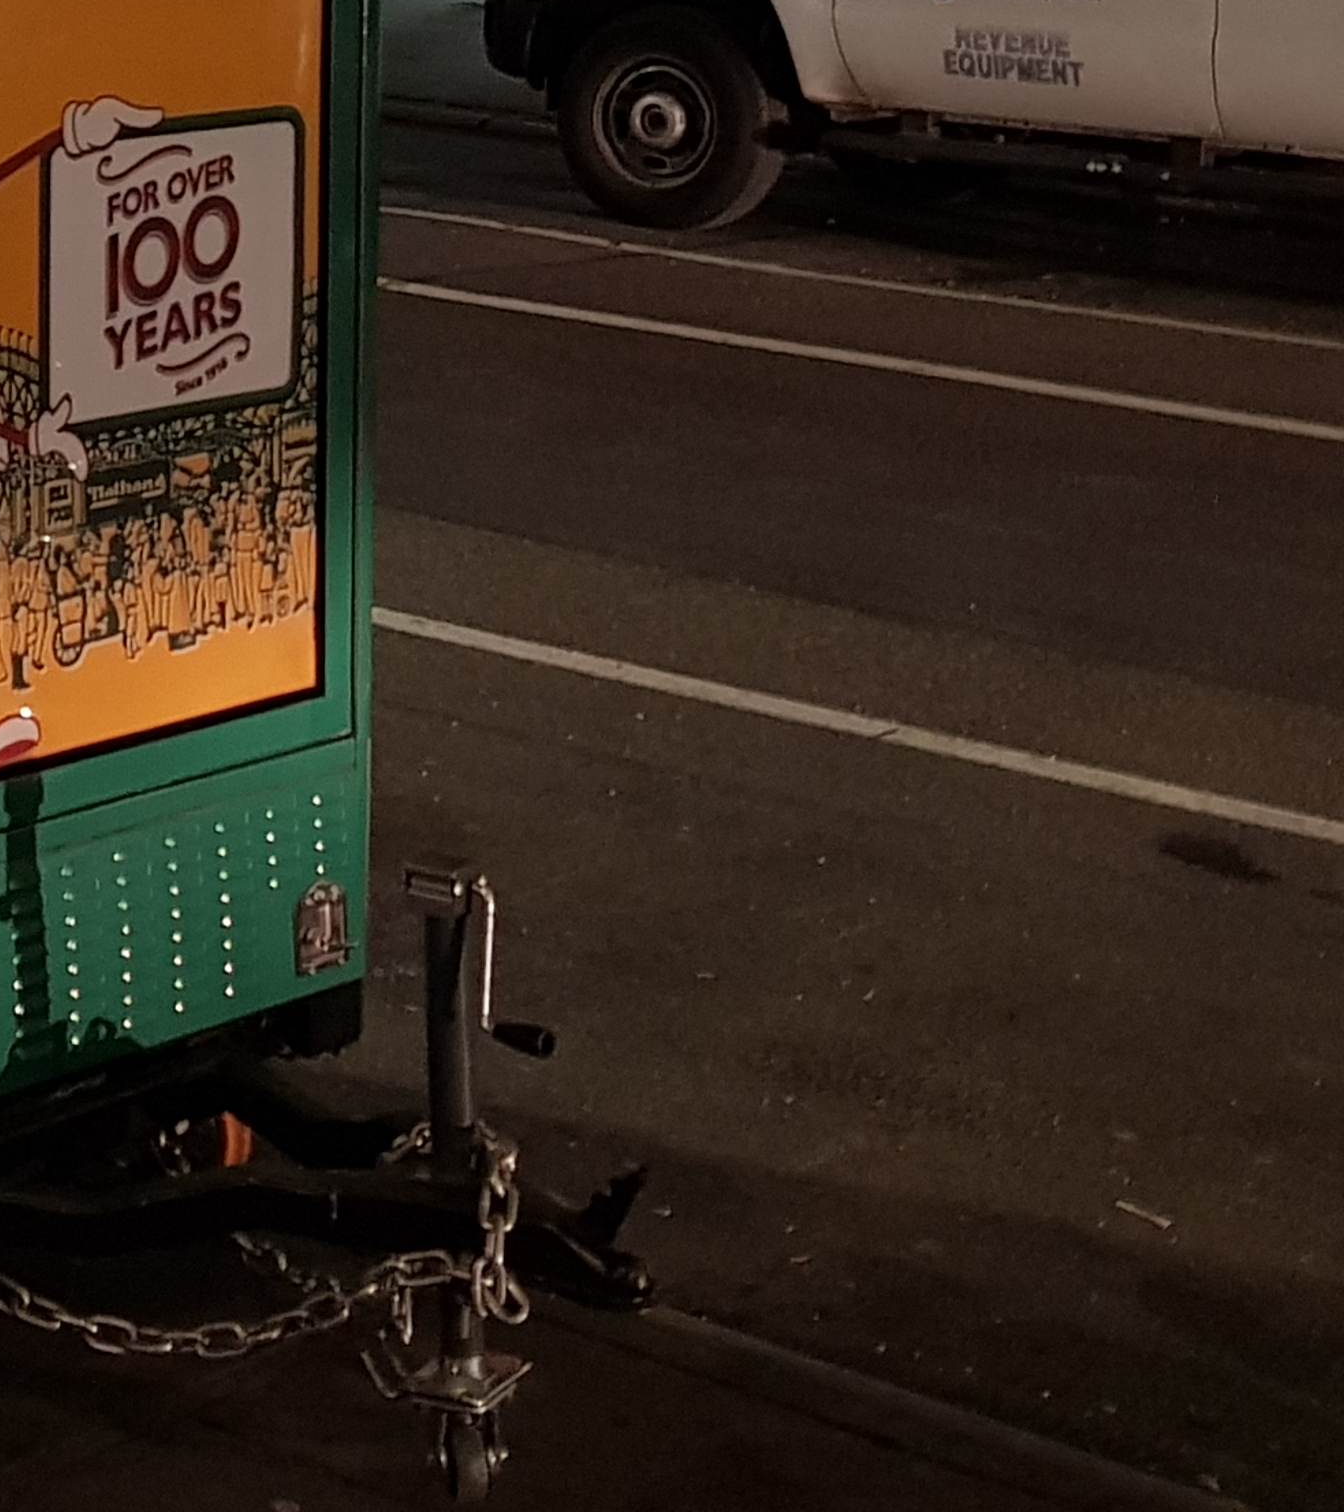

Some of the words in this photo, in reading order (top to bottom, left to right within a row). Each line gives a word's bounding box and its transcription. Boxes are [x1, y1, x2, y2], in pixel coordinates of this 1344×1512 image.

[943, 49, 1083, 87] EQUIPMENT
[955, 25, 1070, 58] REVENUE
[107, 180, 160, 228] FOR
[167, 154, 235, 204] OVER
[105, 195, 241, 321] 100
[104, 281, 243, 371] YEARS
